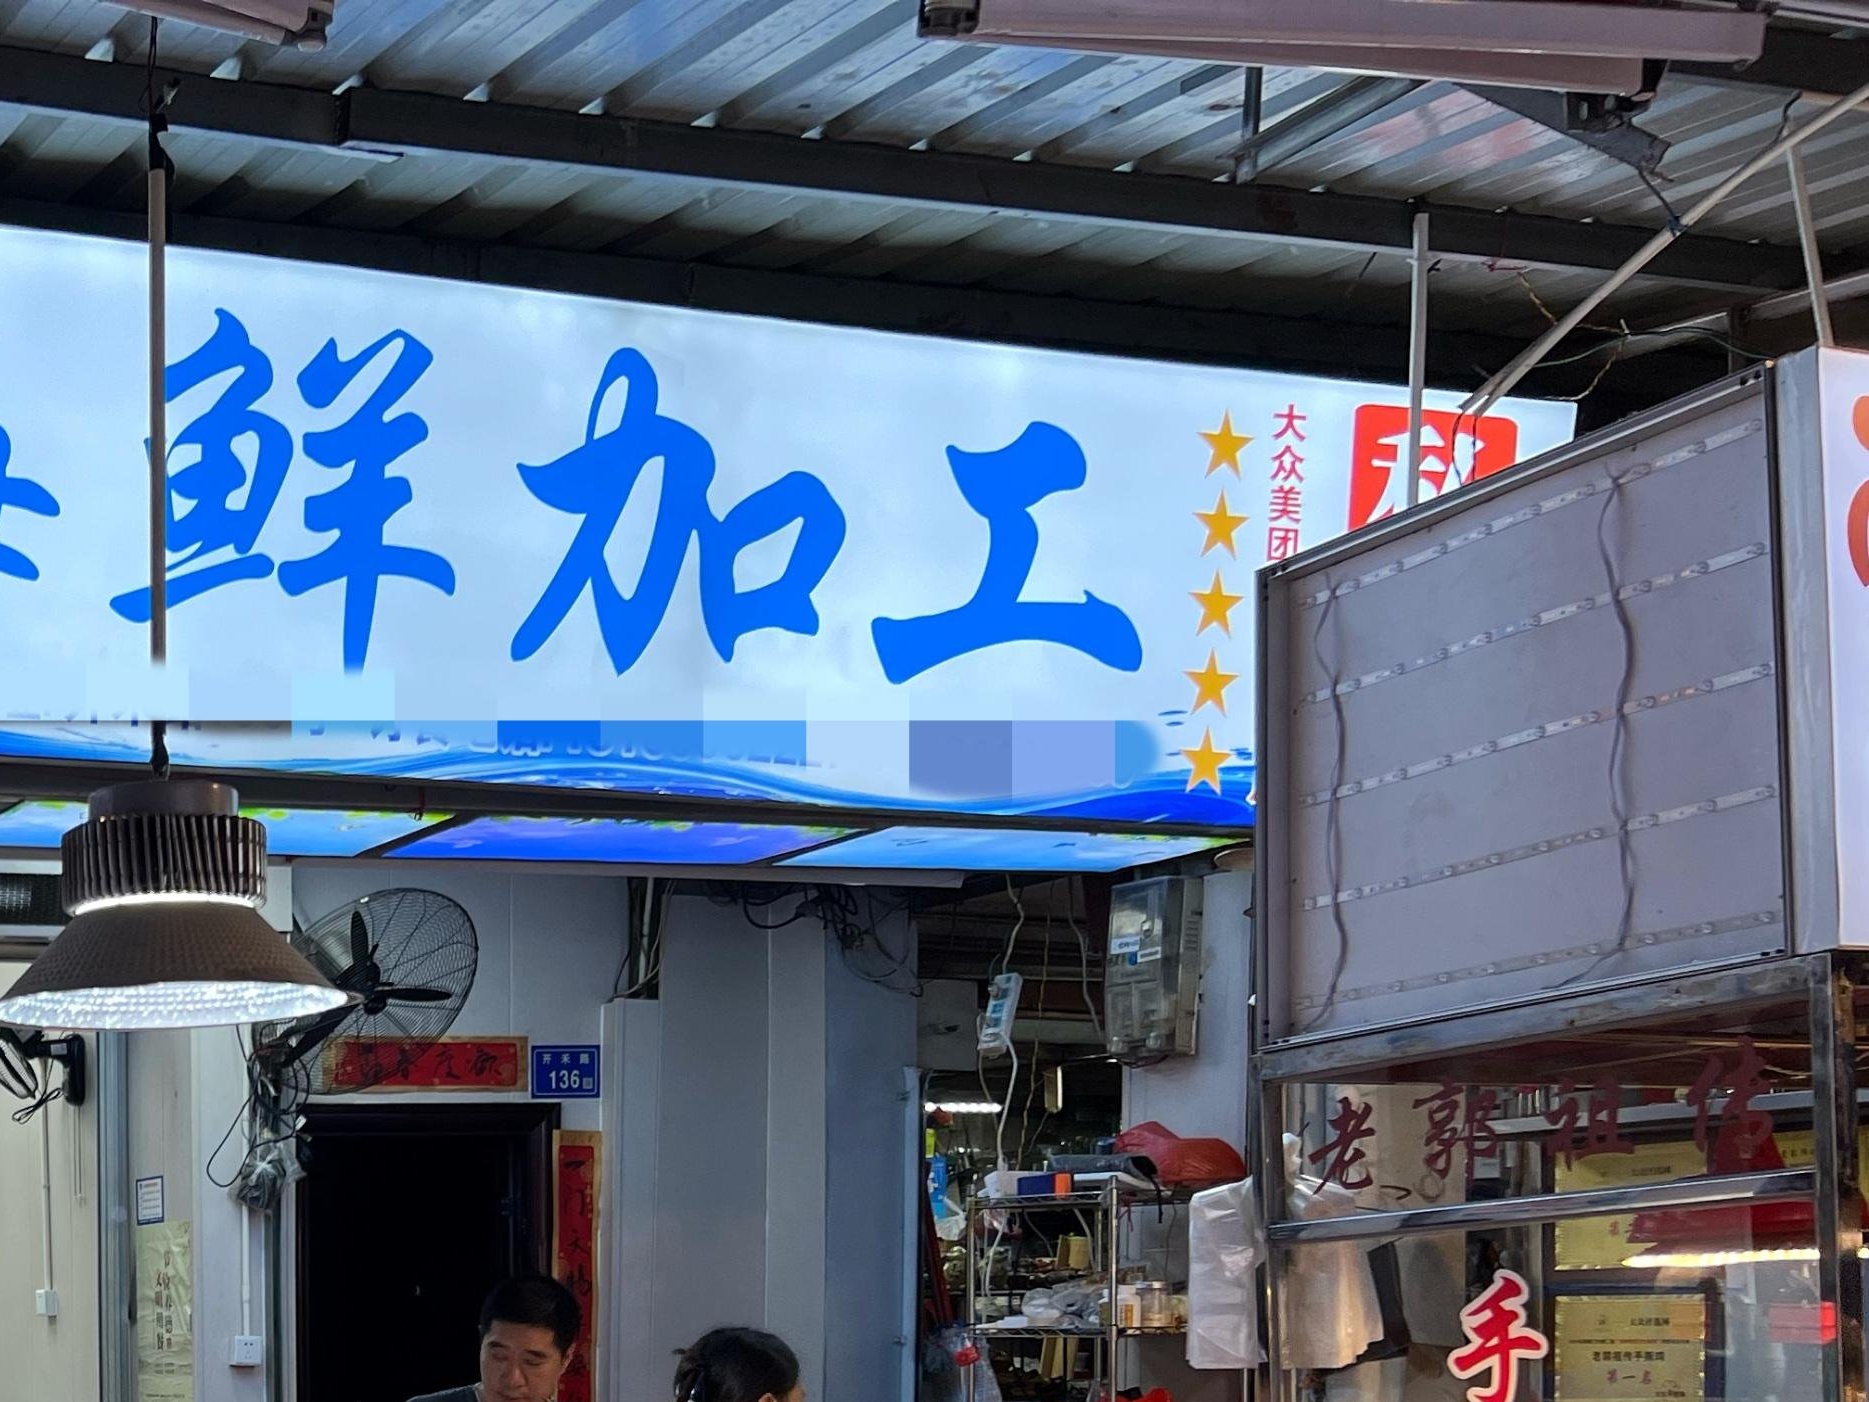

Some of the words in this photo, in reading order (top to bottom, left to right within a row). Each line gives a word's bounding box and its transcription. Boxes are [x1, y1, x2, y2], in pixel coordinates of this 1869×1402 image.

[1267, 403, 1307, 561] 大众美团
[541, 1053, 591, 1065] 开禾路
